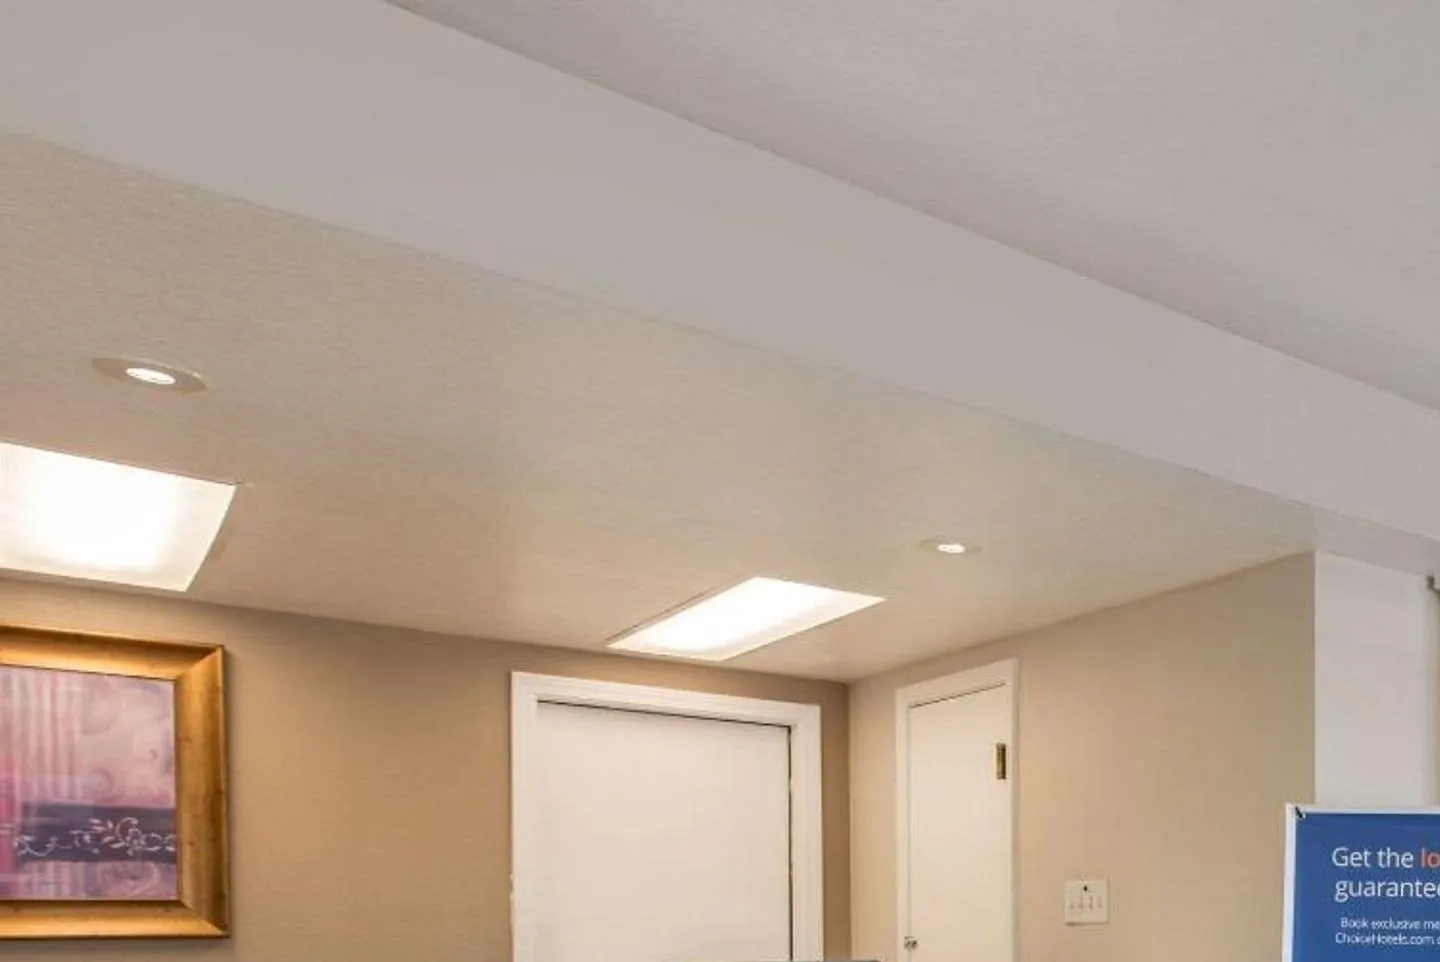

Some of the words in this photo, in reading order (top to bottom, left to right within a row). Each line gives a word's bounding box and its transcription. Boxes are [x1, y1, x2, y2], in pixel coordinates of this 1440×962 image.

[1332, 847, 1370, 868] Get
[1378, 848, 1413, 868] the
[1340, 917, 1368, 928] Book
[1371, 917, 1420, 930] exclusive
